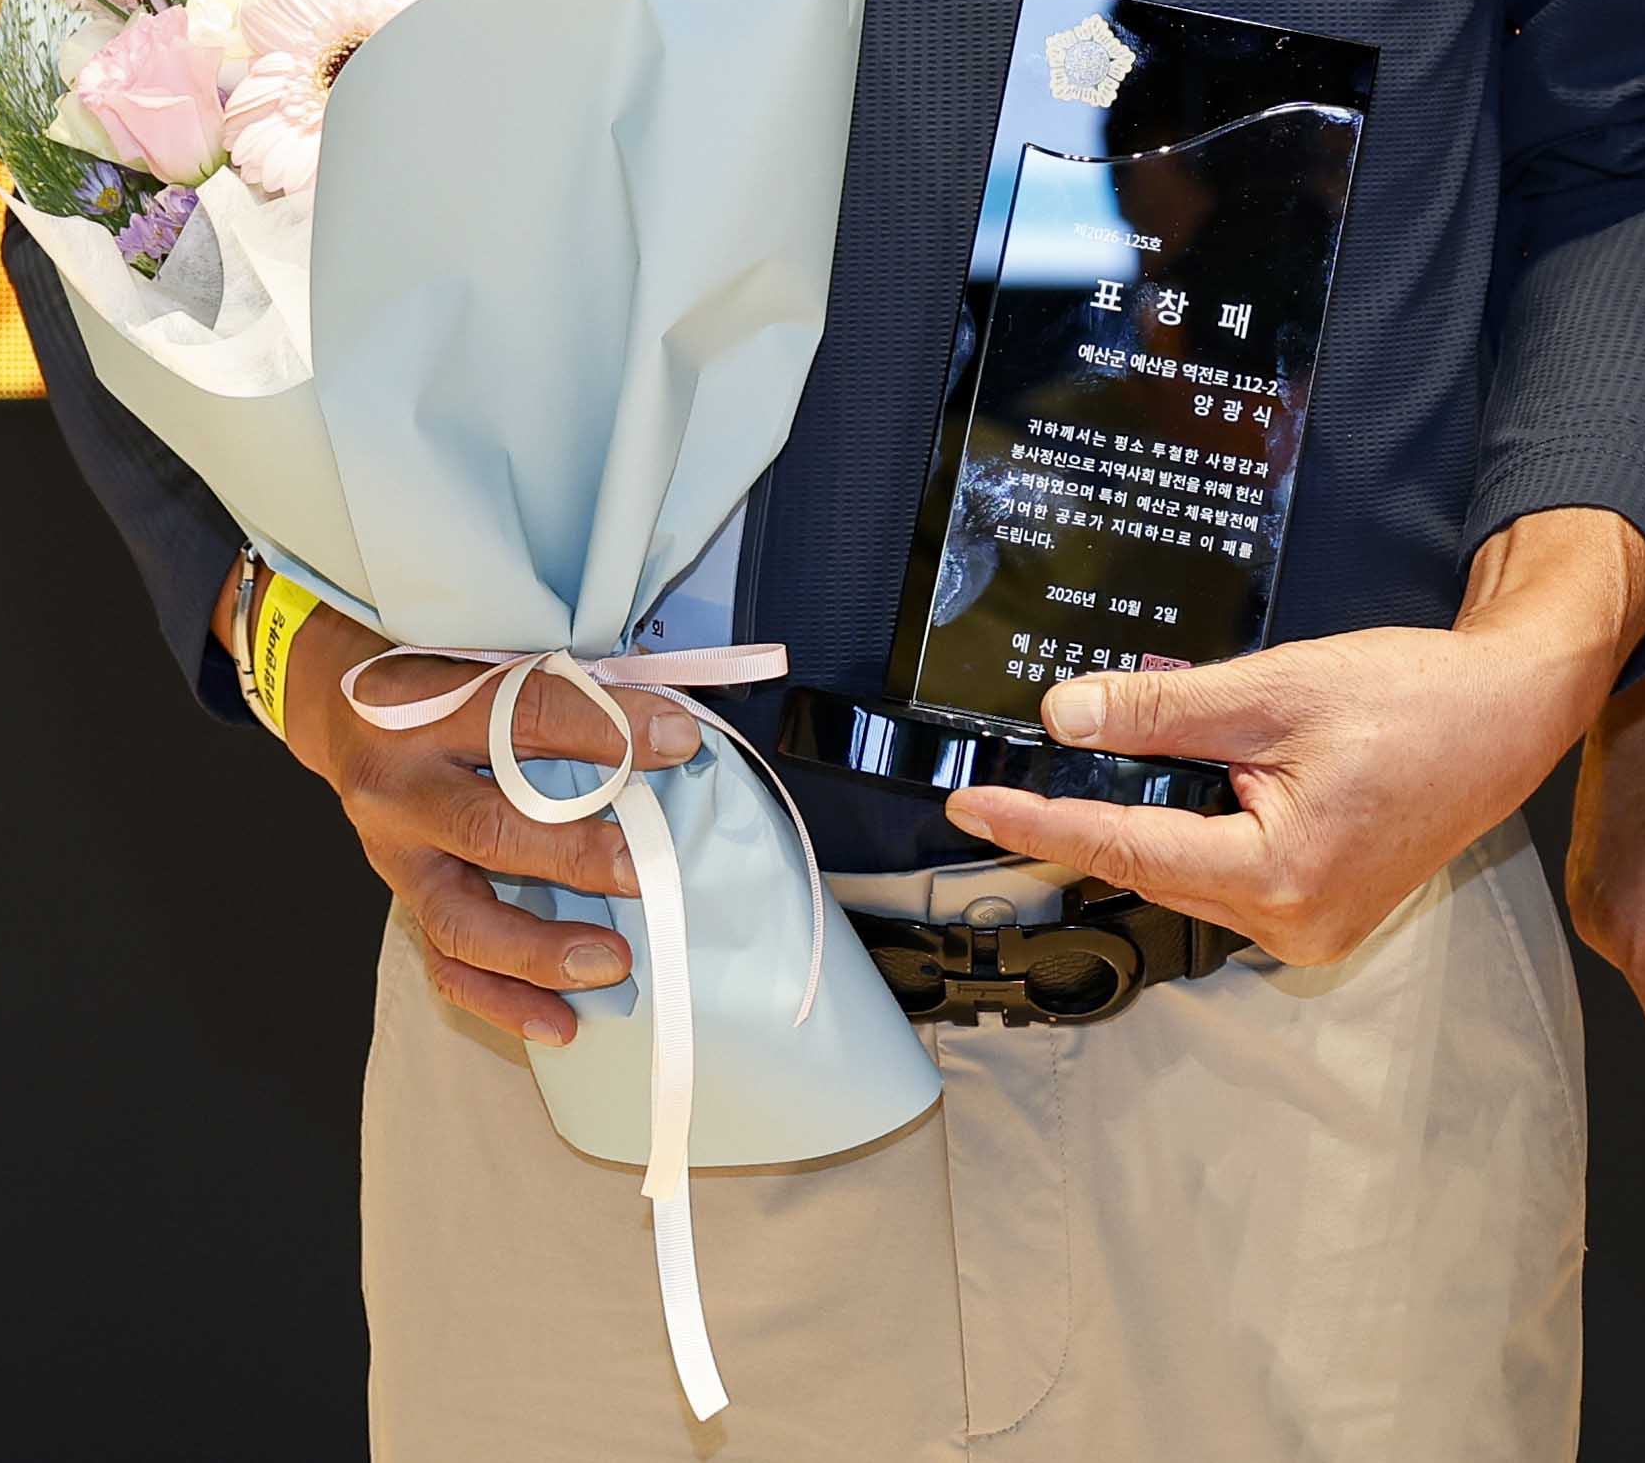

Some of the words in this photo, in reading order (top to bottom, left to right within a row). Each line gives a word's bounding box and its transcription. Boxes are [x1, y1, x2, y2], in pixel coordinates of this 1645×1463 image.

[1073, 222, 1163, 252] 제2026-125호
[1078, 343, 1126, 368] 예산군
[1130, 353, 1178, 378] 예산읍
[1182, 363, 1229, 387] 역전로
[1232, 374, 1278, 397] 112-2
[1011, 443, 1096, 473] 봉사정신으로
[1098, 460, 1156, 485] 지역사회
[1158, 470, 1201, 494] 발전을
[1203, 479, 1233, 499] 위해
[1235, 485, 1264, 506] 헌신
[1027, 418, 1107, 448] 귀하께서는
[1114, 434, 1145, 454] 평소
[1151, 442, 1200, 465] 투철한
[1205, 453, 1270, 479] 사명감과
[1001, 498, 1049, 520] 기여한
[1055, 507, 1104, 531] 공로가
[1110, 518, 1192, 547] 지대하므로
[1200, 535, 1214, 552] 이
[1221, 539, 1254, 559] 패를
[1004, 470, 1095, 501] 노력하였으며
[1098, 487, 1128, 508] 특히
[1136, 495, 1181, 518] 예산군
[1184, 504, 1259, 533] 체육발전에
[994, 525, 1056, 550] 드립니다.
[1045, 585, 1097, 609] 2026년
[1108, 597, 1142, 617] 10월
[1153, 606, 1179, 624] 2일
[1006, 659, 1045, 682] 의장
